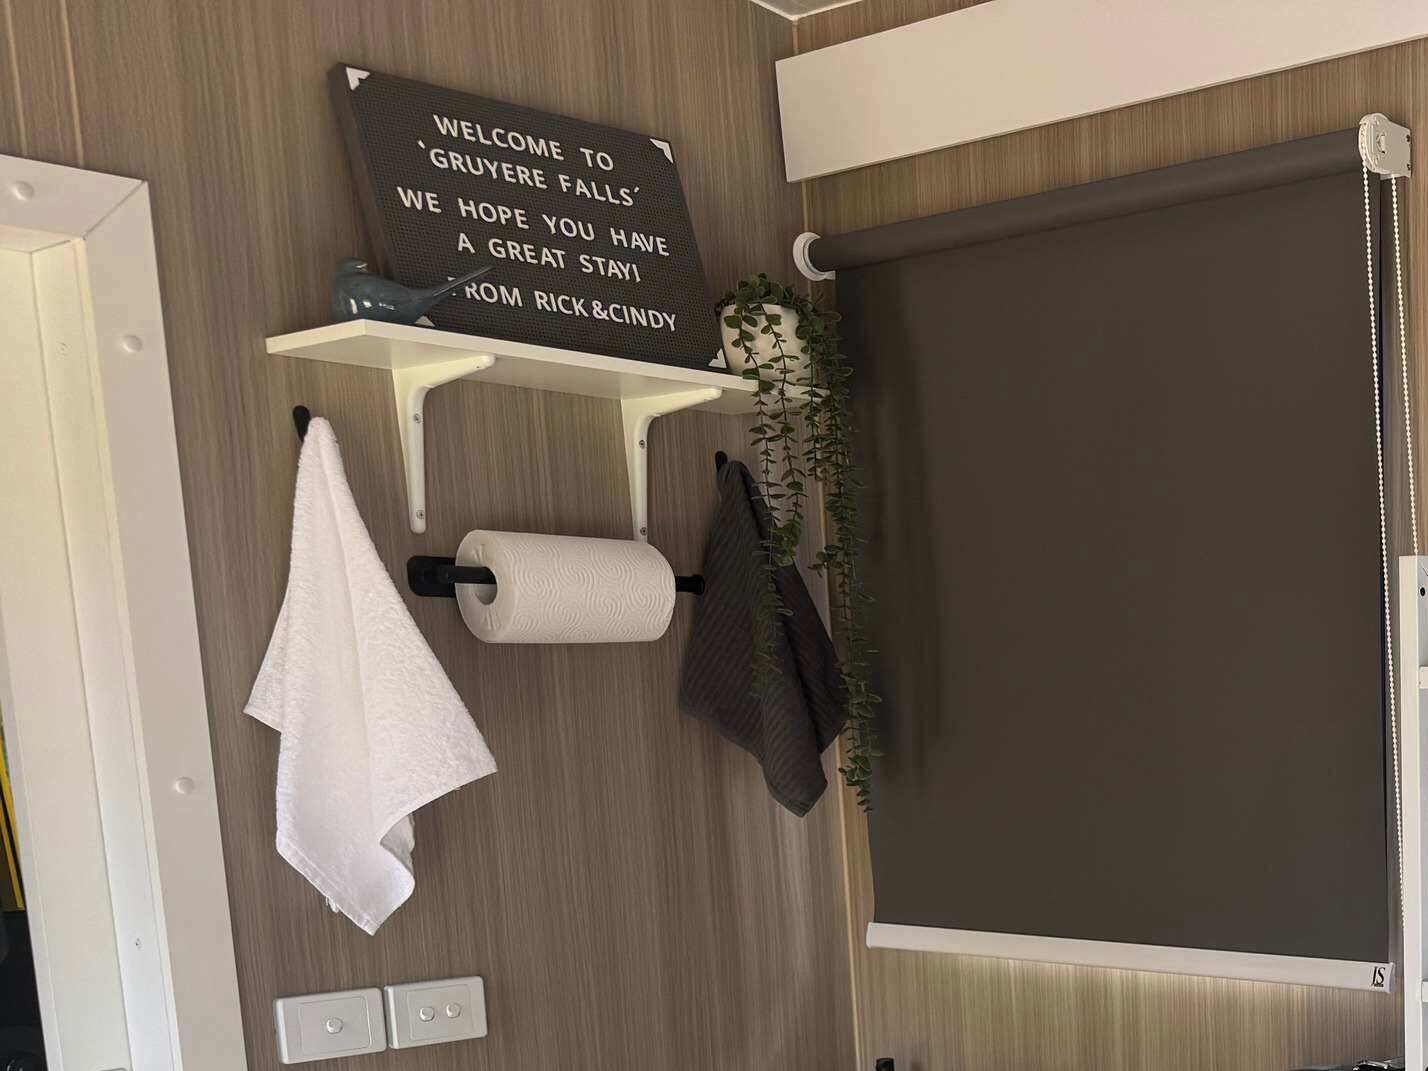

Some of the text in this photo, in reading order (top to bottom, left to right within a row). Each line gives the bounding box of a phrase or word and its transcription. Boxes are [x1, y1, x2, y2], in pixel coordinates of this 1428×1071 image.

[433, 114, 614, 171] WELCOME TO
[396, 186, 670, 257] WE HOPE YOU HAVE
[457, 232, 476, 254] A
[488, 238, 566, 269] GREAT
[447, 276, 523, 308] ROM
